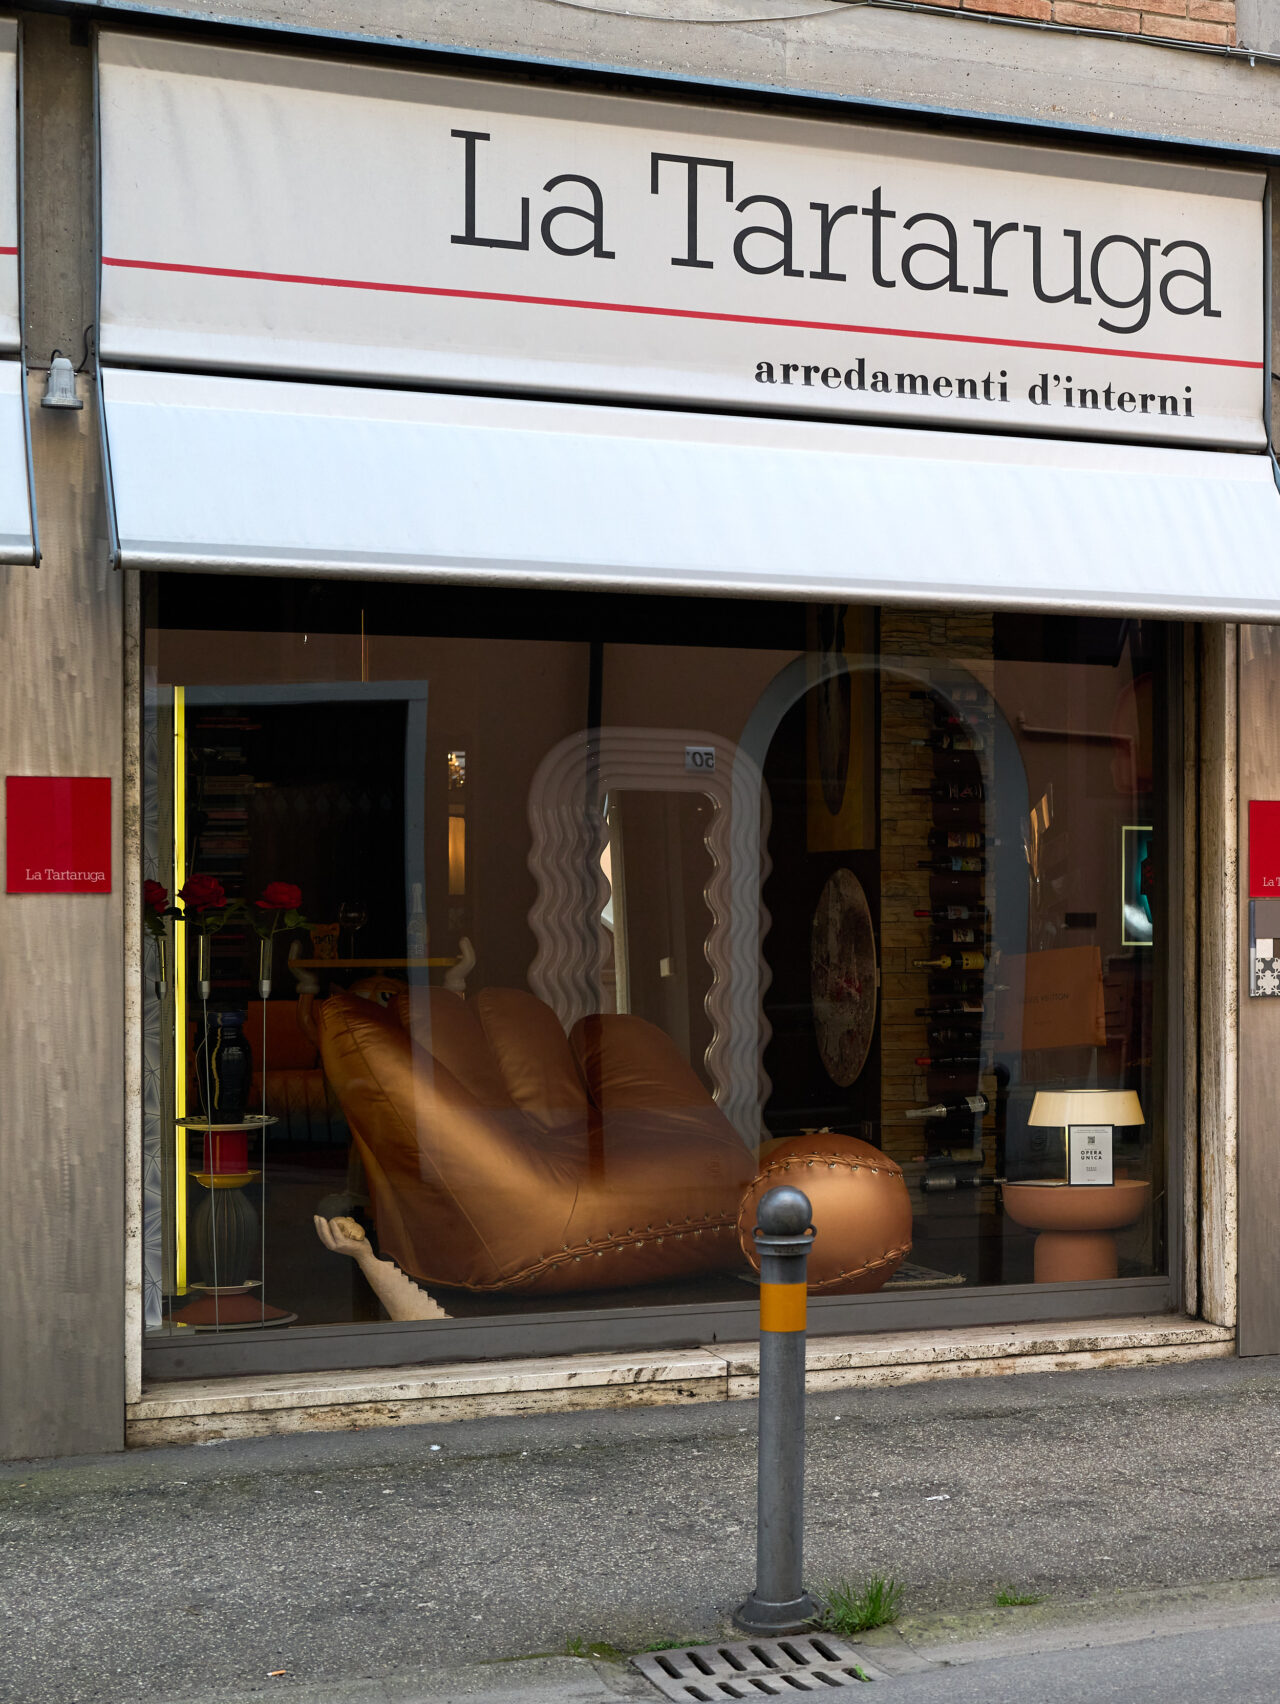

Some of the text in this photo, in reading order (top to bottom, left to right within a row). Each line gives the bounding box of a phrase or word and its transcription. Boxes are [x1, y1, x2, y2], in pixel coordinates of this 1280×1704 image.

[450, 128, 1222, 335] La Tartaruga
[754, 357, 1195, 418] arredamenti d'interni
[26, 868, 106, 883] La Tartaruga
[1263, 876, 1275, 887] La
